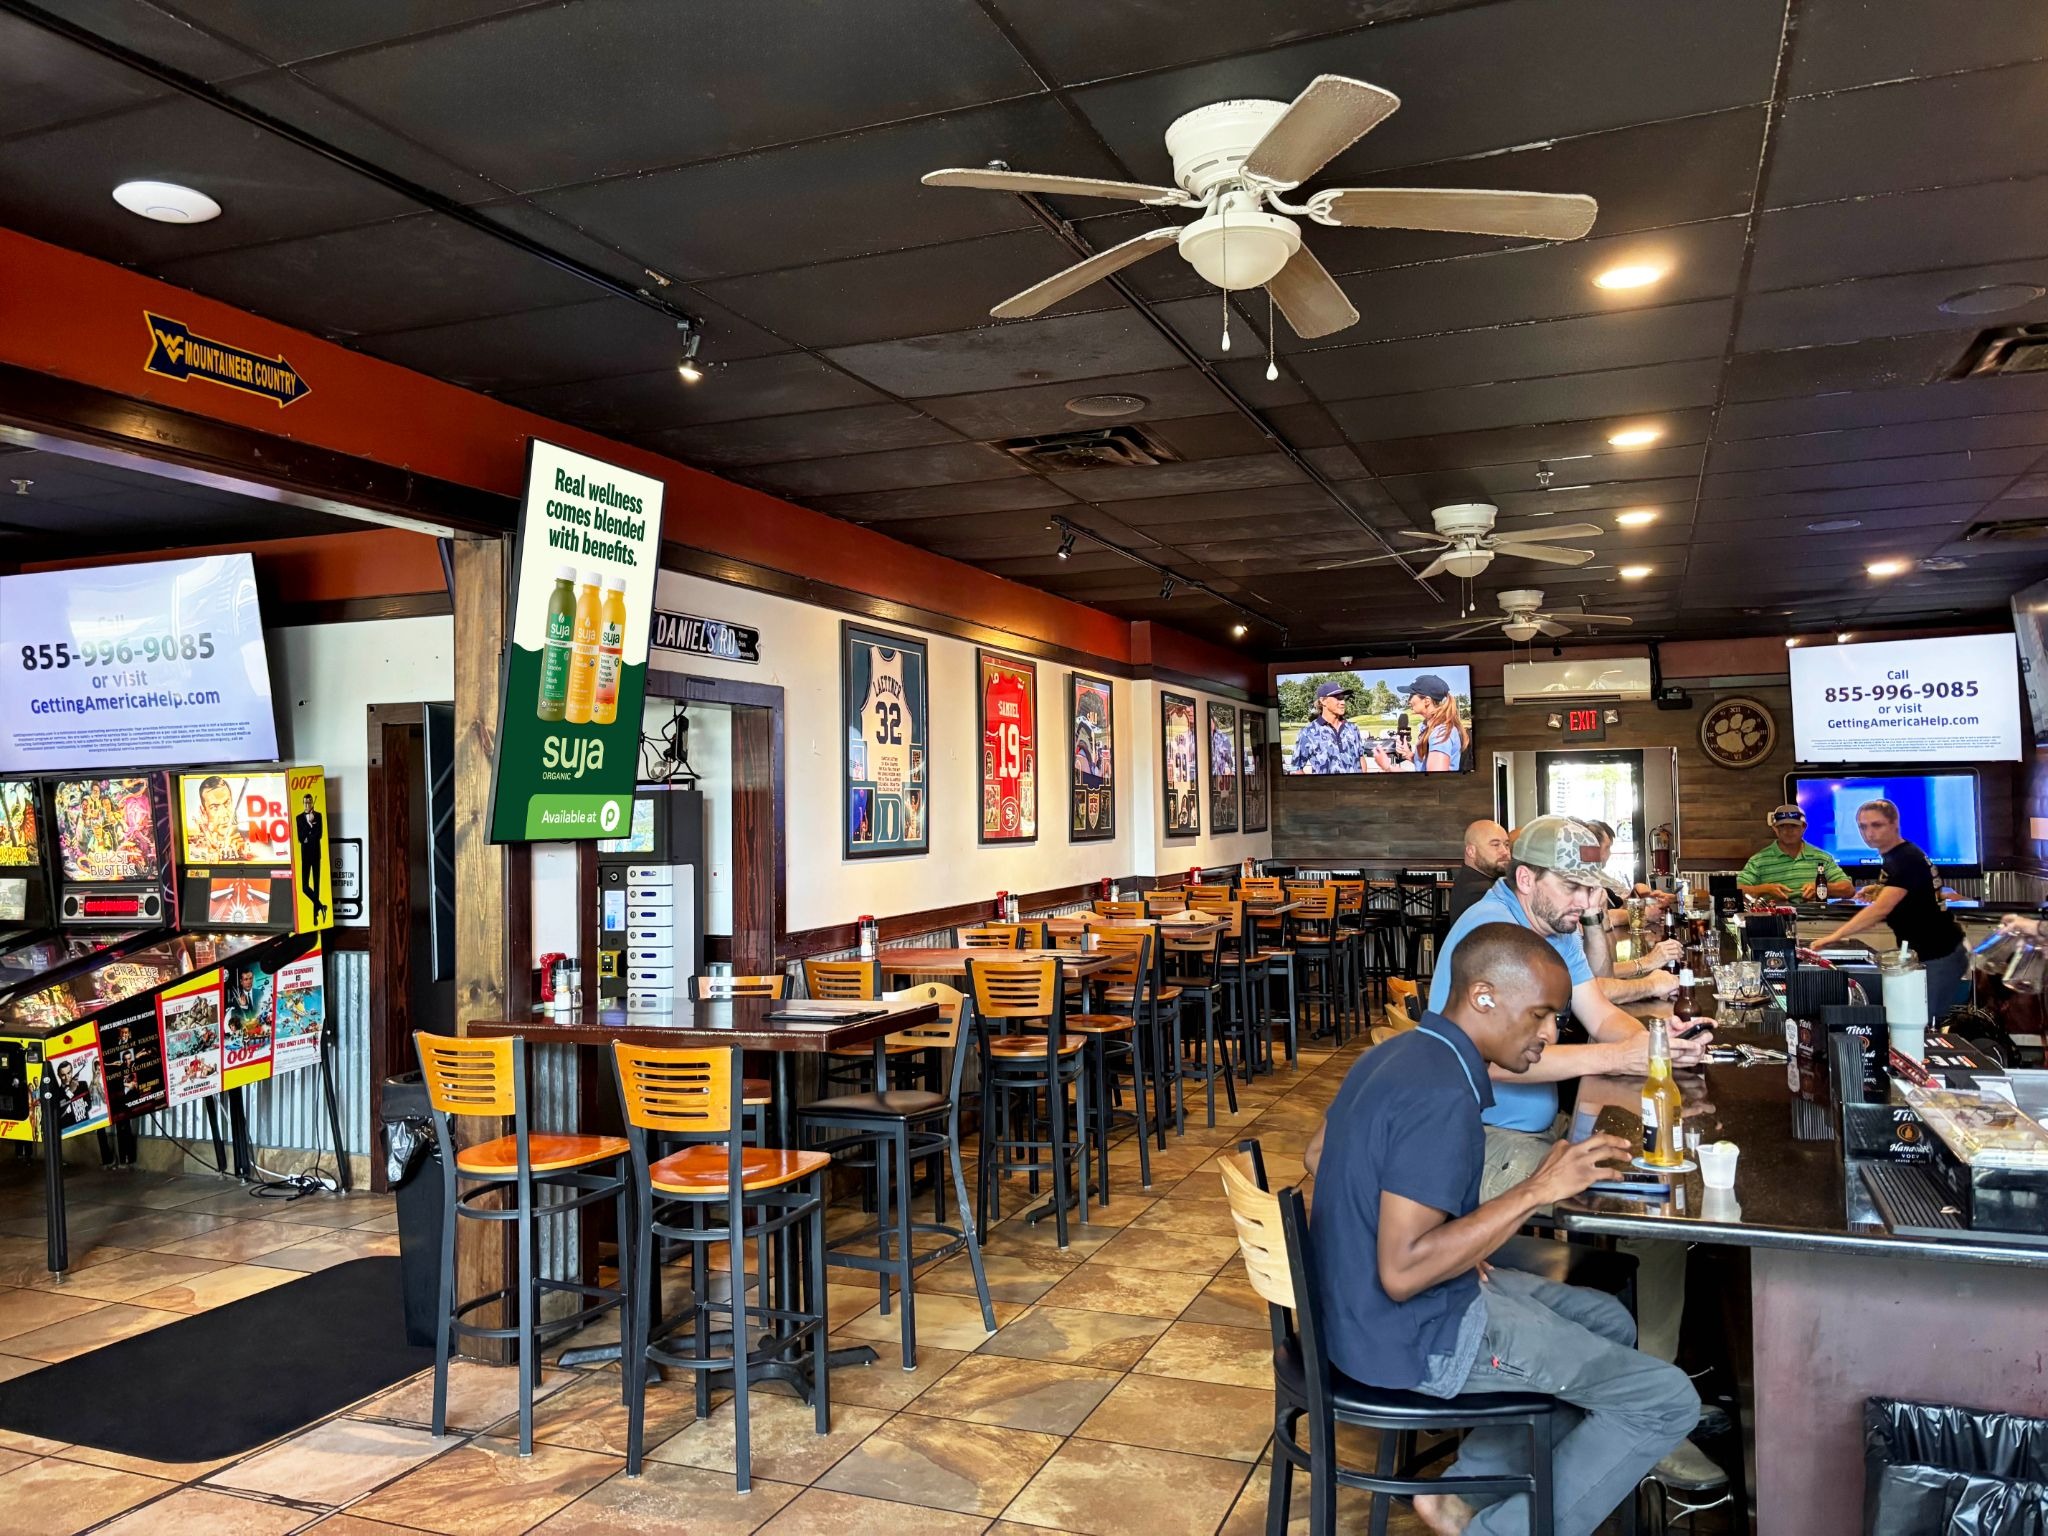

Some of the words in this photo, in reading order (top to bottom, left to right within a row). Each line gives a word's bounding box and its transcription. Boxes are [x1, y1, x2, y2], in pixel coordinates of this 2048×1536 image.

[185, 340, 253, 383] MOUNTAINEER
[255, 362, 296, 396] COUNTRY
[555, 467, 586, 498] Real
[588, 482, 643, 514] wellness
[546, 499, 592, 527] comes
[594, 506, 646, 542] blended
[549, 525, 580, 553] with
[582, 531, 637, 567] benefits.
[550, 623, 570, 639] suja
[602, 631, 620, 646] suja
[656, 615, 716, 652] DANIEL'S
[719, 627, 736, 655] RD
[21, 632, 215, 671] 855-996-9085
[92, 674, 108, 689] or
[112, 670, 148, 688] visit
[1887, 669, 1909, 681] Call
[873, 674, 901, 700] LAETTNER
[1825, 680, 1979, 703] 855-996-9085
[31, 689, 220, 715] GettingAmericaHelp.com
[1878, 704, 1890, 714] or
[1895, 703, 1923, 714] visit
[875, 701, 903, 745] 32
[1569, 709, 1598, 731] EXIT
[1827, 716, 1979, 730] GettingAmericaHelp.com
[542, 735, 604, 779] suja
[998, 722, 1021, 779] 19
[291, 775, 319, 790] 007
[542, 772, 572, 780] ORGANIC
[246, 794, 288, 818] DR.
[541, 809, 586, 824] Available
[587, 811, 598, 823] at
[249, 819, 290, 845] NO
[90, 863, 137, 876] BUSTERS
[1846, 1025, 1871, 1036] Tito's
[227, 1046, 259, 1065] 007
